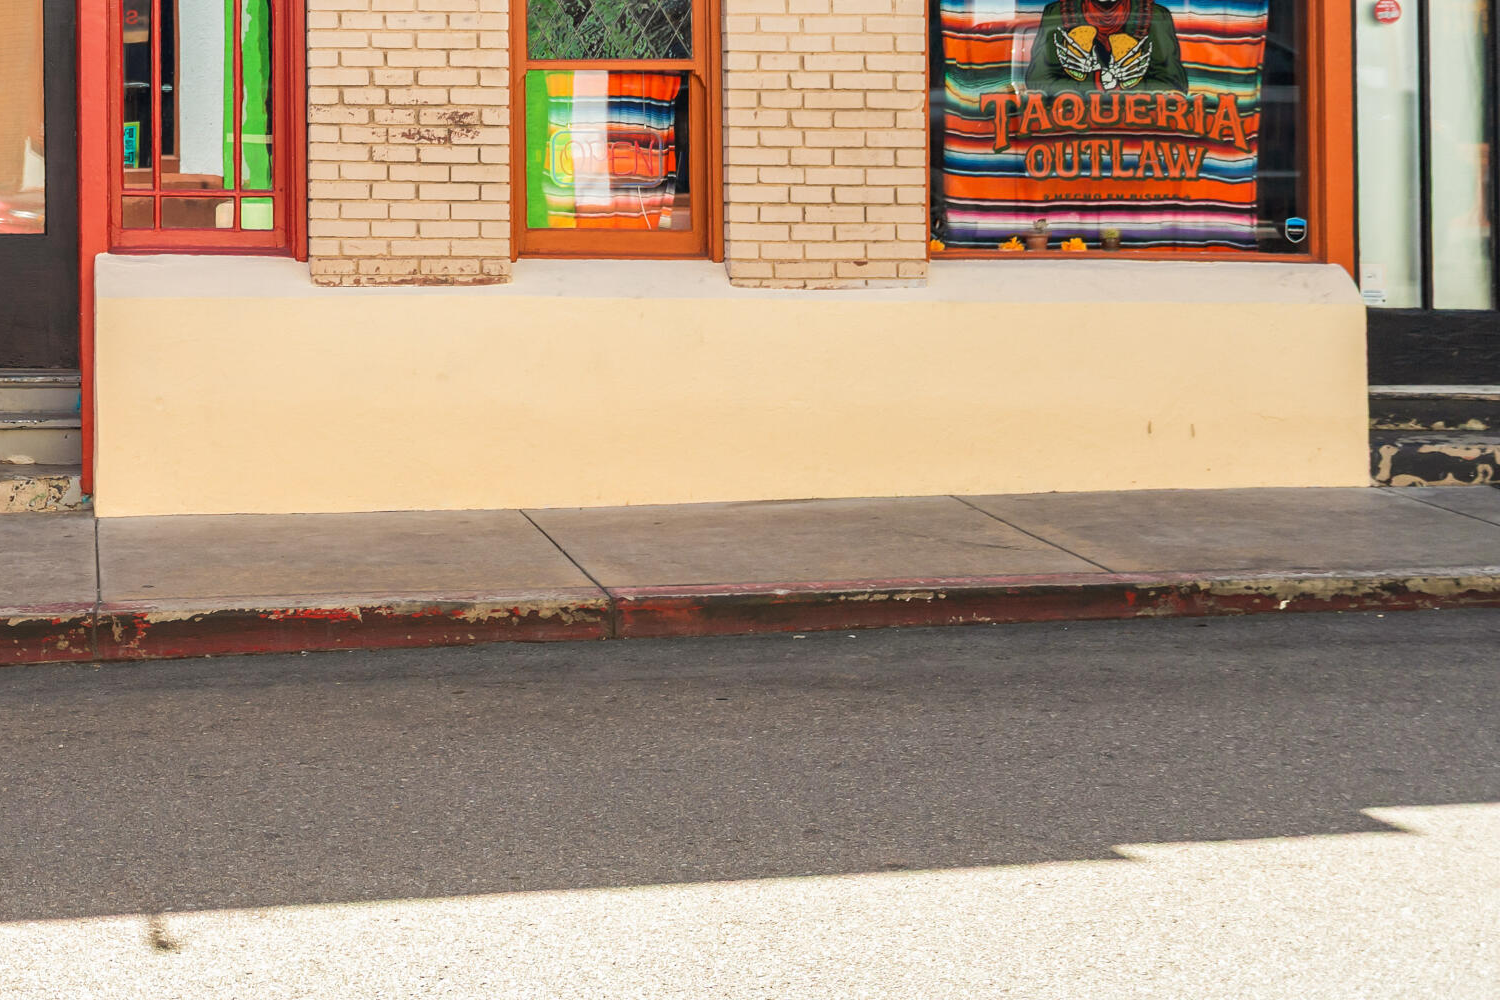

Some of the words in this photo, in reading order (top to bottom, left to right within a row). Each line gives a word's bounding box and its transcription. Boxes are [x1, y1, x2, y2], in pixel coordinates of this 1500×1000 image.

[979, 90, 1251, 153] TAQUERIA
[560, 140, 655, 176] OPEN
[1025, 138, 1208, 181] OUTLAW
